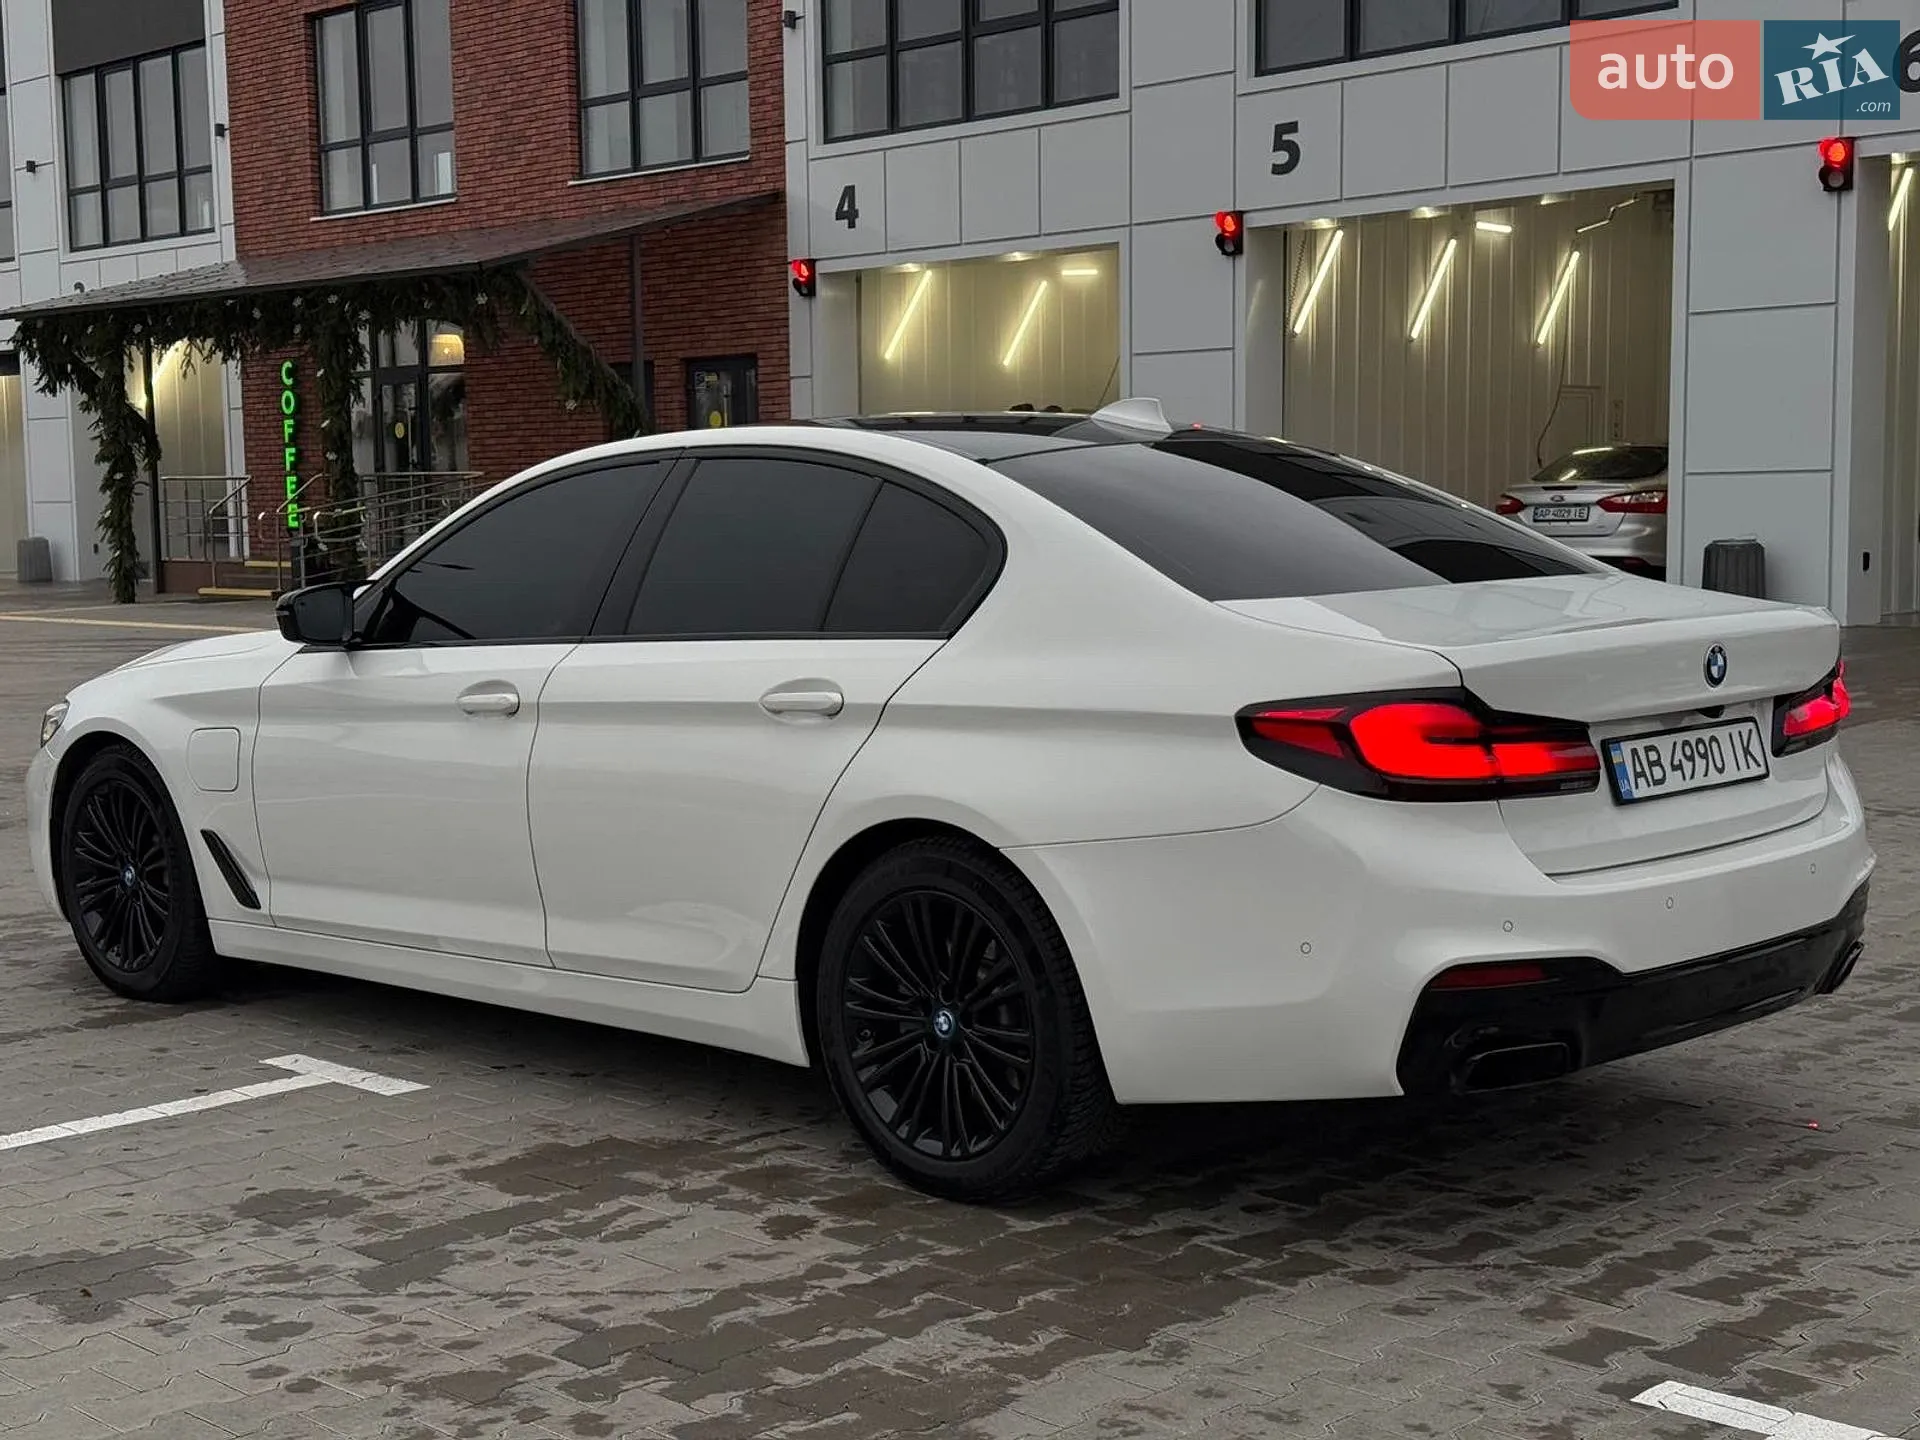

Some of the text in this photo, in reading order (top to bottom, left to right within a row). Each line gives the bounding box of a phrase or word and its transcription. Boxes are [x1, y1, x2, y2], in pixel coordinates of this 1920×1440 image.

[1893, 29, 1920, 93] 6
[1271, 120, 1301, 175] 5
[835, 184, 859, 229] 4
[281, 360, 299, 528] COFFEE
[1630, 728, 1761, 790] AB 4990 IK
